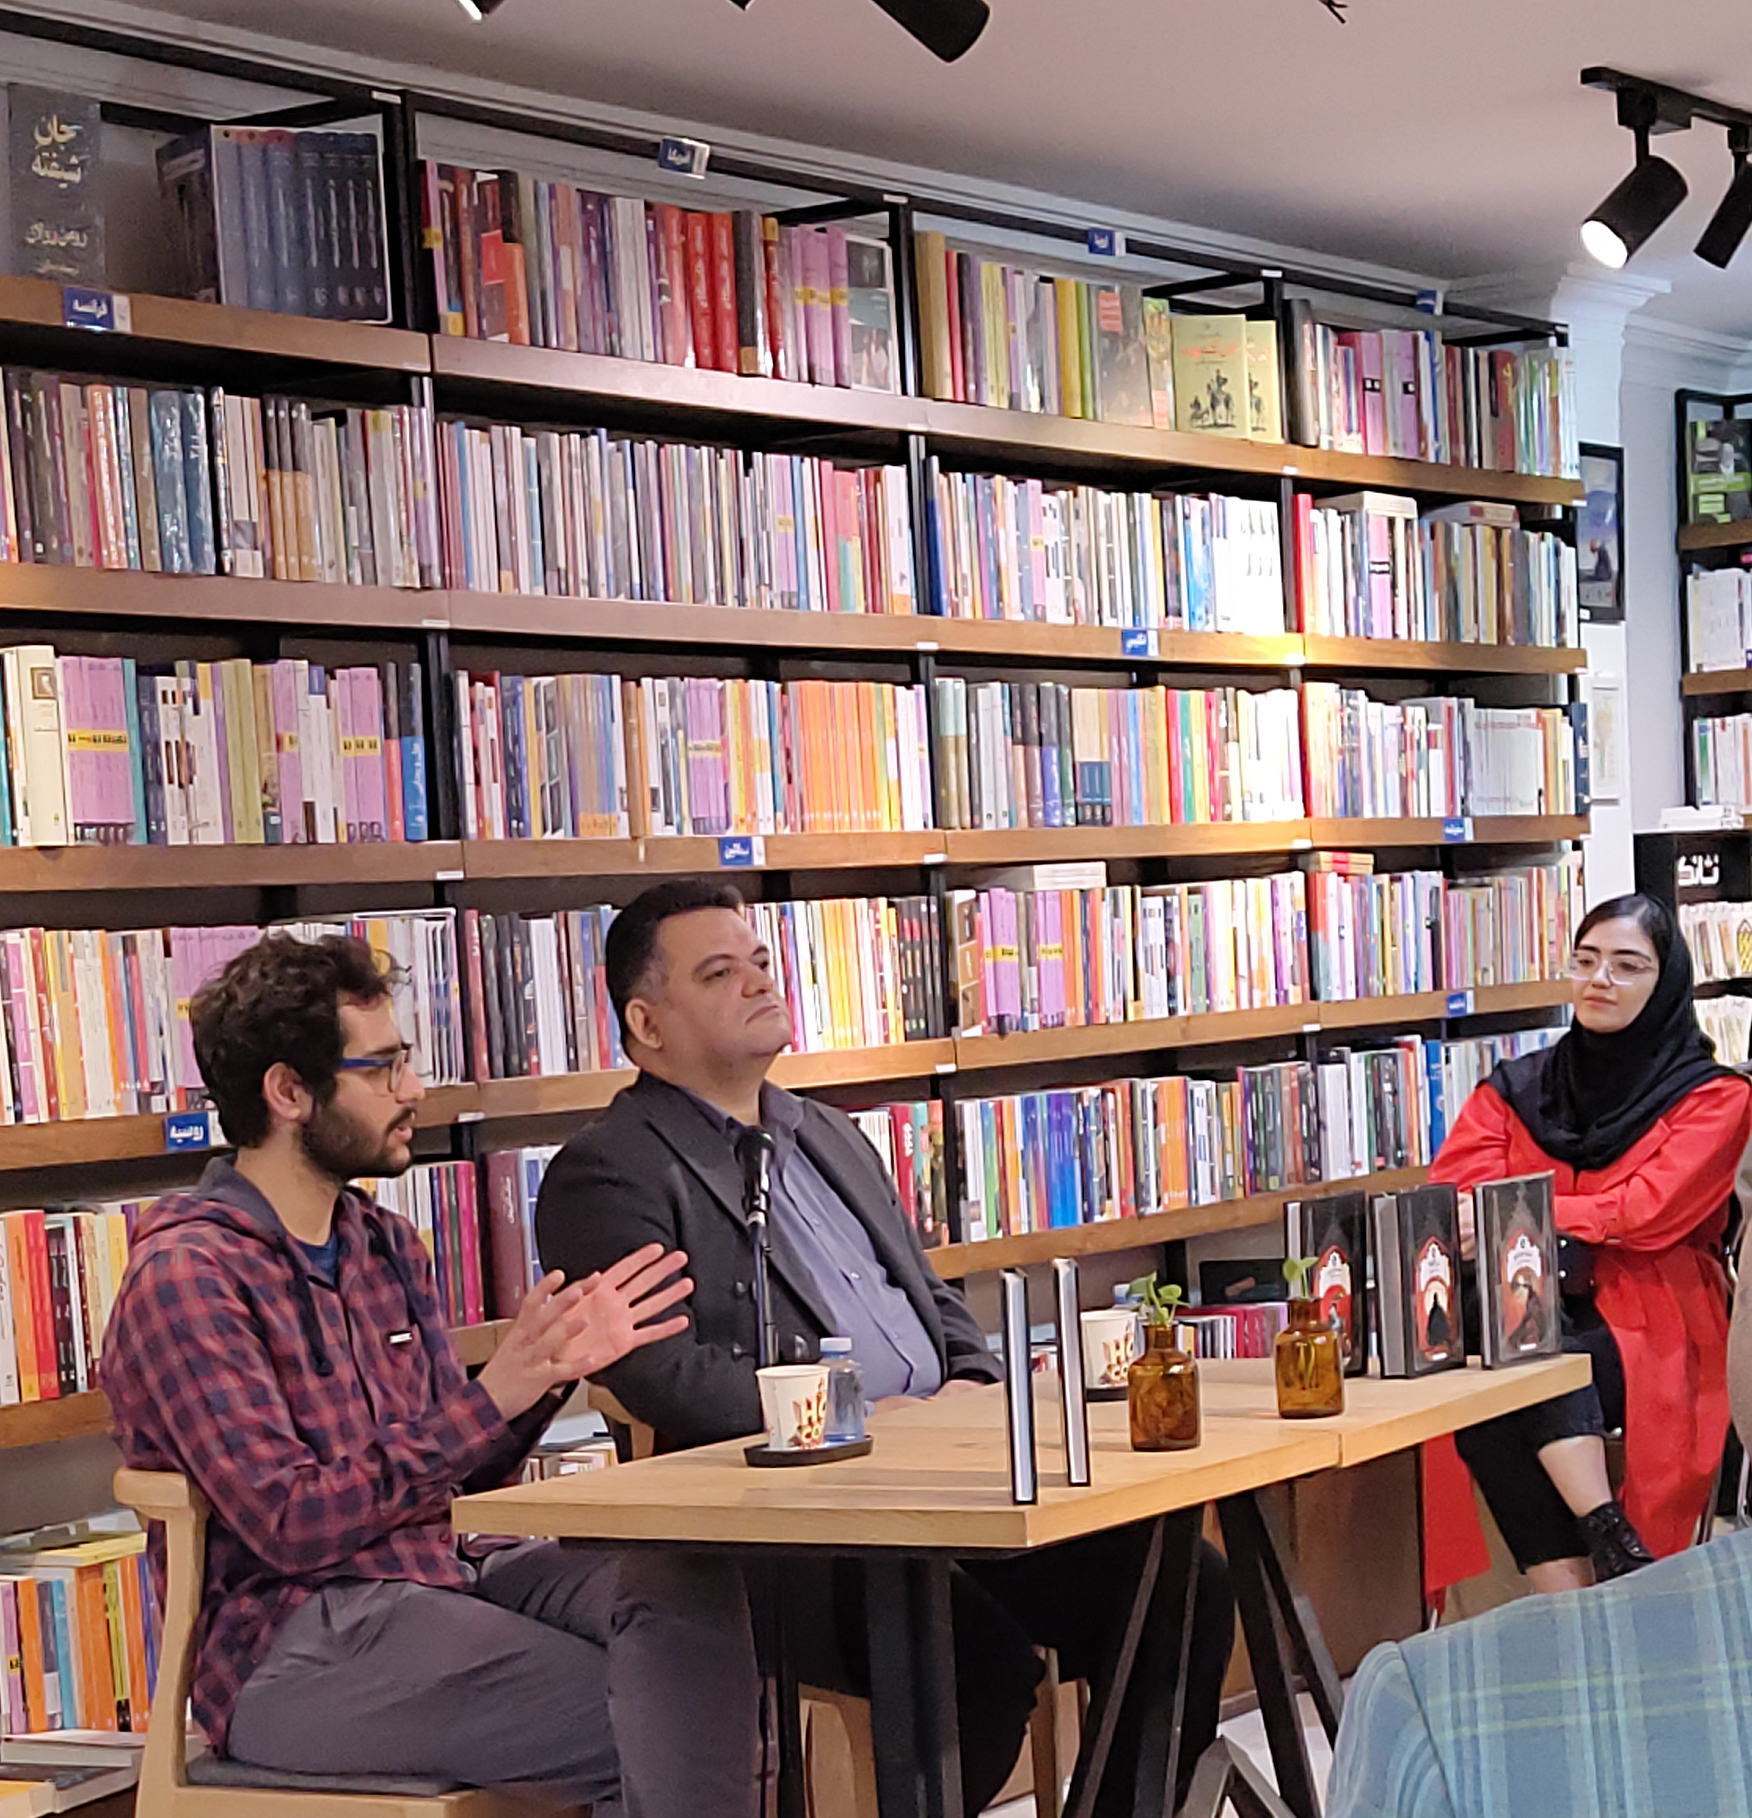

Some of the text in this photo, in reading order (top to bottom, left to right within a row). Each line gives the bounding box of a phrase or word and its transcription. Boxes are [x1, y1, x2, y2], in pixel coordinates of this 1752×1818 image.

[34, 114, 83, 150] جان
[31, 151, 83, 189] شیفته
[169, 1124, 205, 1144] روسیه
